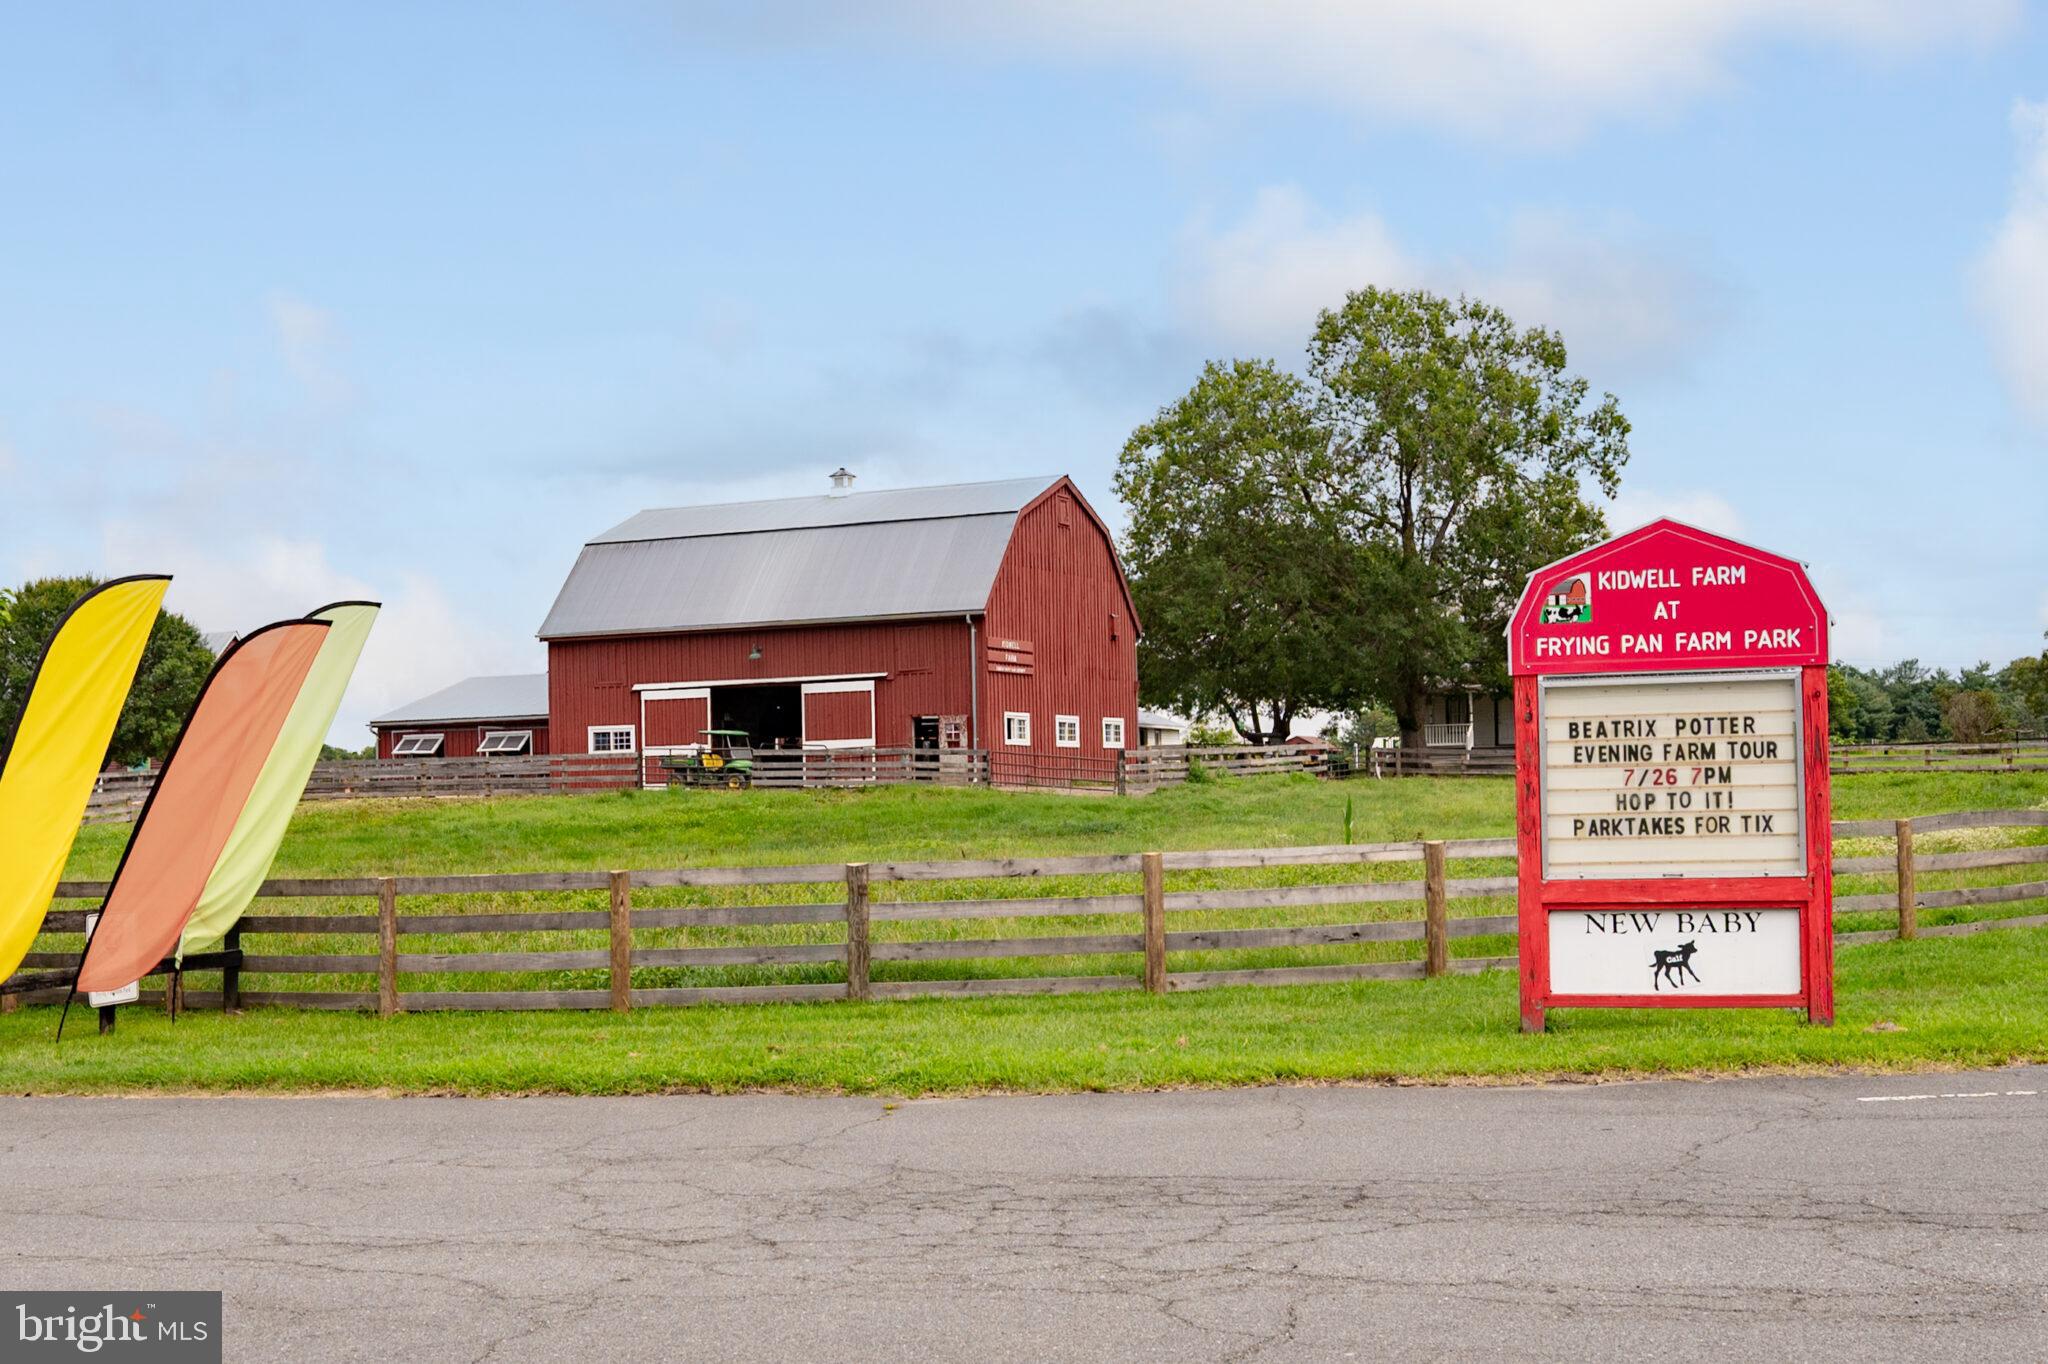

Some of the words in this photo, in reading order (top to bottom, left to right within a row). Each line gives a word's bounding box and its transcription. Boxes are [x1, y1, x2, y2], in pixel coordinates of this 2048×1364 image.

[1598, 567, 1681, 590] KIDWELL
[1692, 565, 1746, 586] FARM
[1654, 600, 1680, 620] AT
[1536, 635, 1610, 657] FRYING
[1621, 633, 1663, 654] PAN
[1675, 631, 1732, 652] FARM
[1744, 628, 1801, 650] PARK
[1569, 719, 1657, 739] BEATRIX
[1675, 716, 1756, 736] POTTER
[1574, 744, 1653, 763] EVENING
[1663, 742, 1716, 762] FARM
[1727, 741, 1778, 760] TOUR
[1623, 768, 1678, 786] 7/26
[1691, 766, 1732, 785] 7PM
[1616, 793, 1656, 811] HOP
[1667, 791, 1692, 810] TO
[1705, 791, 1734, 809] IT!
[1573, 817, 1686, 836] PARKTAKES
[1695, 816, 1731, 834] FOR
[1740, 814, 1775, 833] TIX
[1584, 913, 1662, 934] NEW
[1676, 911, 1764, 933] BABY
